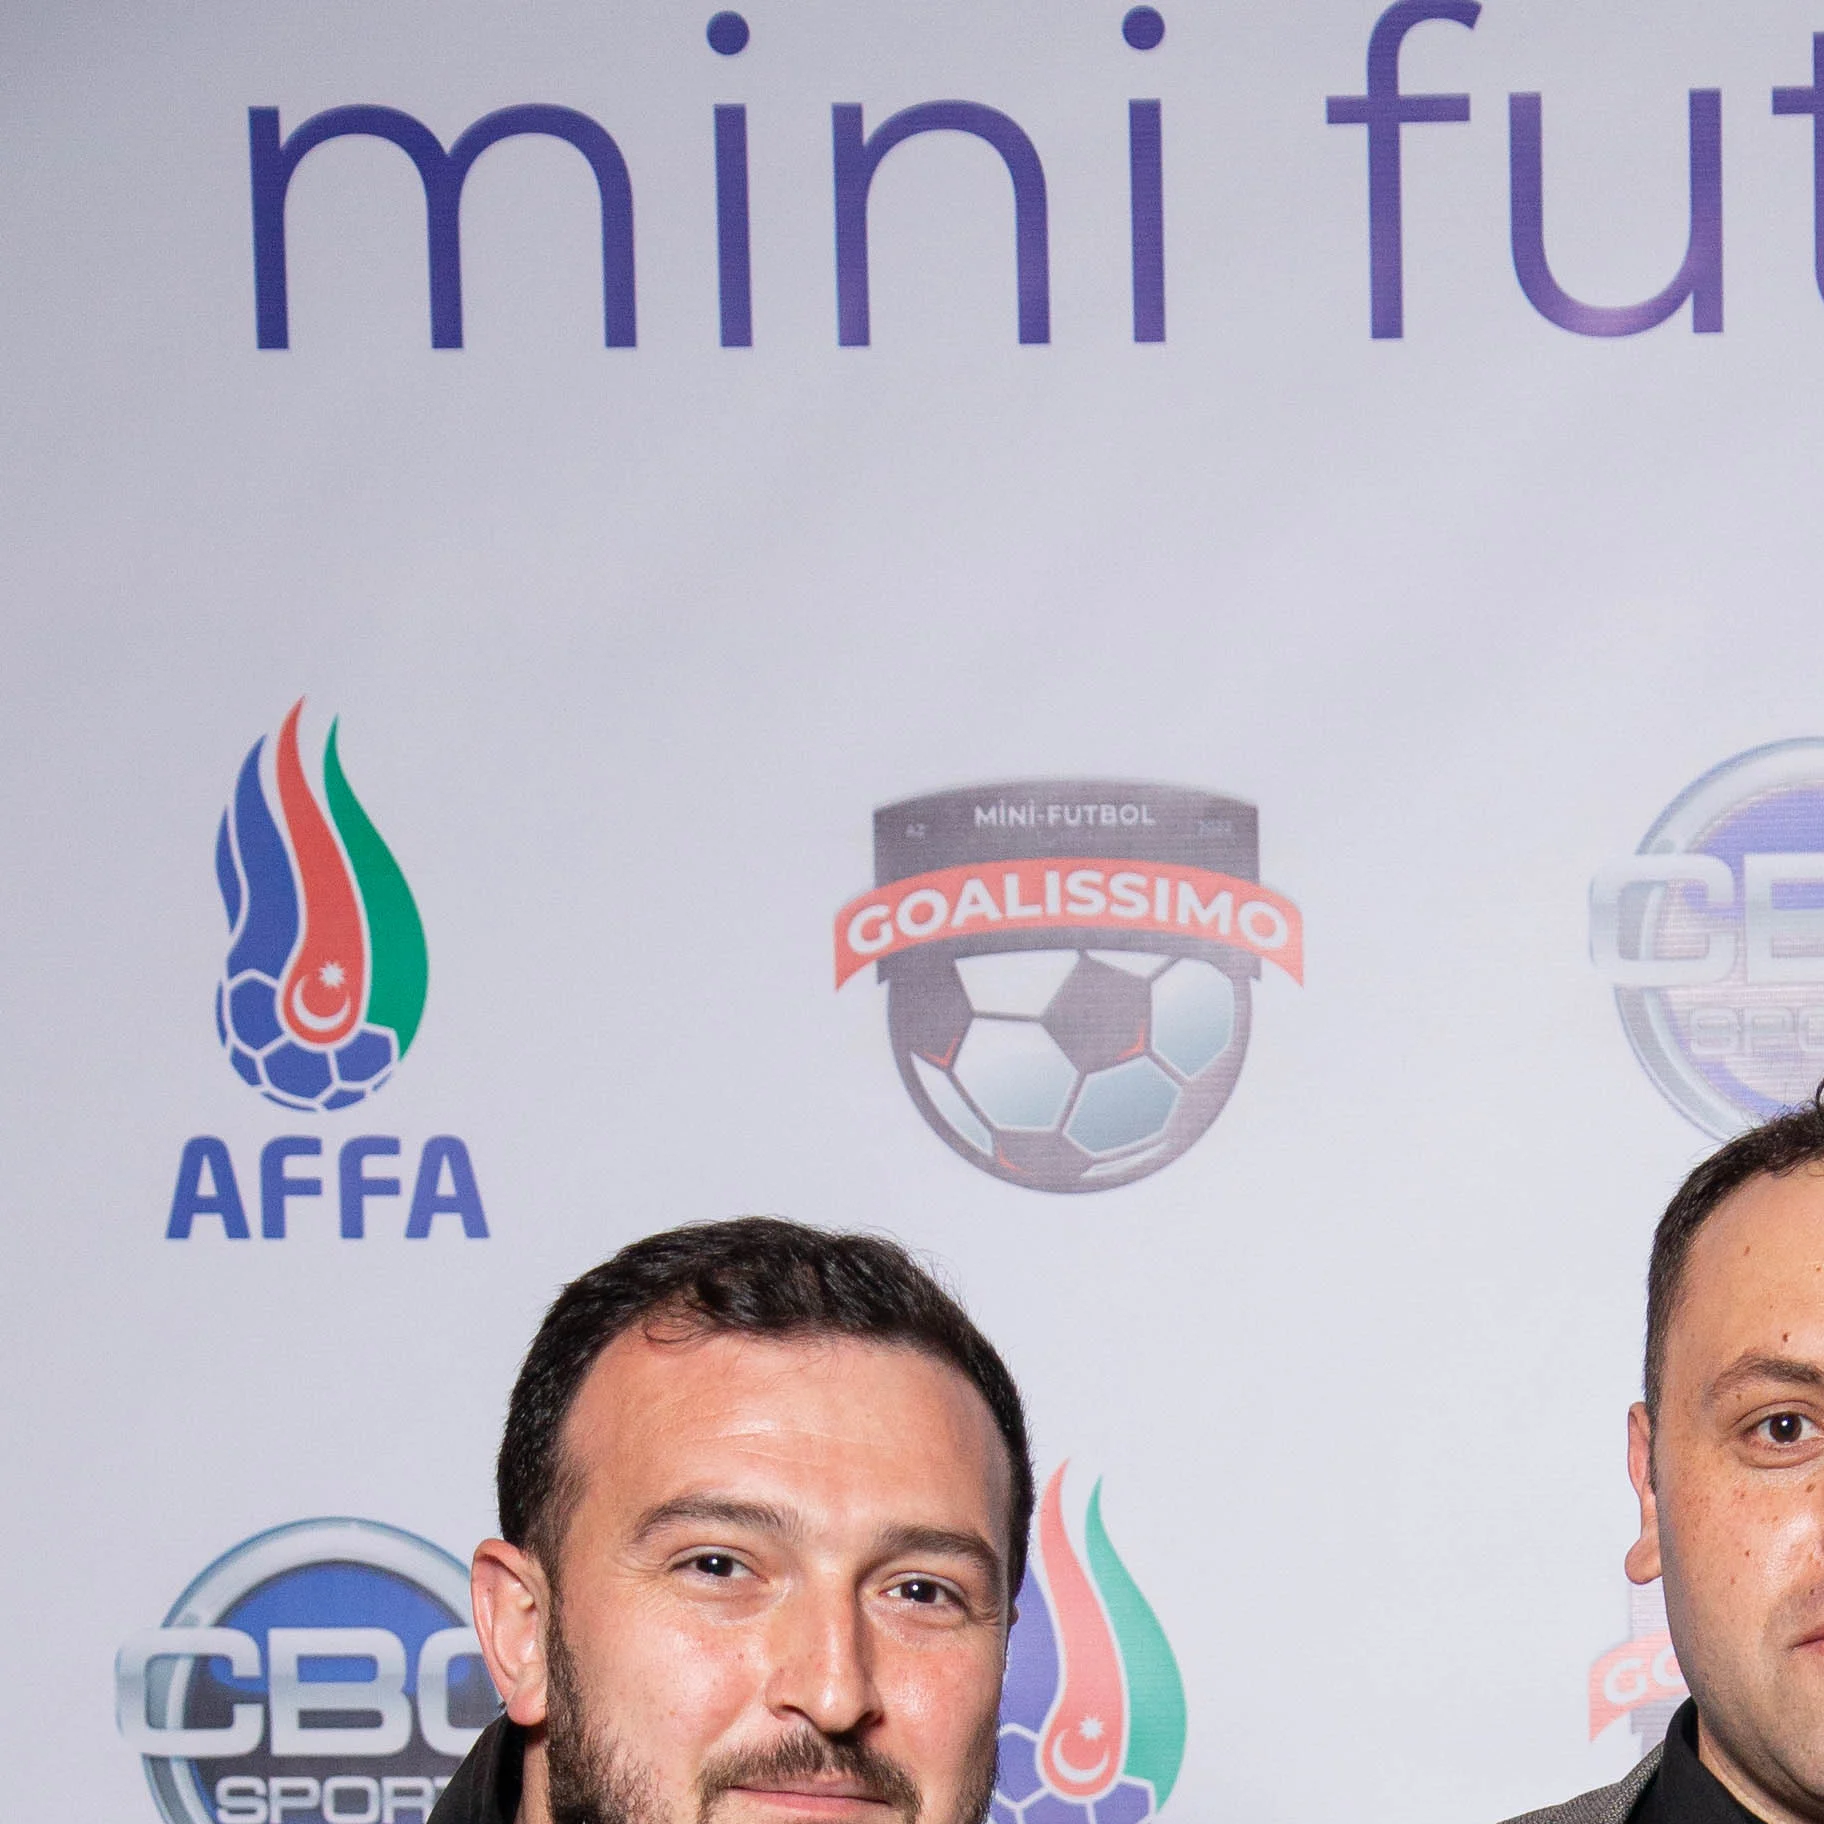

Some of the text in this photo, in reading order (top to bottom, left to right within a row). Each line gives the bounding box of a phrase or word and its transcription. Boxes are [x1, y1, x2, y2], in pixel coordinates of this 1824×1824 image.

[248, 7, 1166, 350] mini
[847, 869, 1289, 955] GOALISSIMO
[165, 1134, 490, 1240] AFFA
